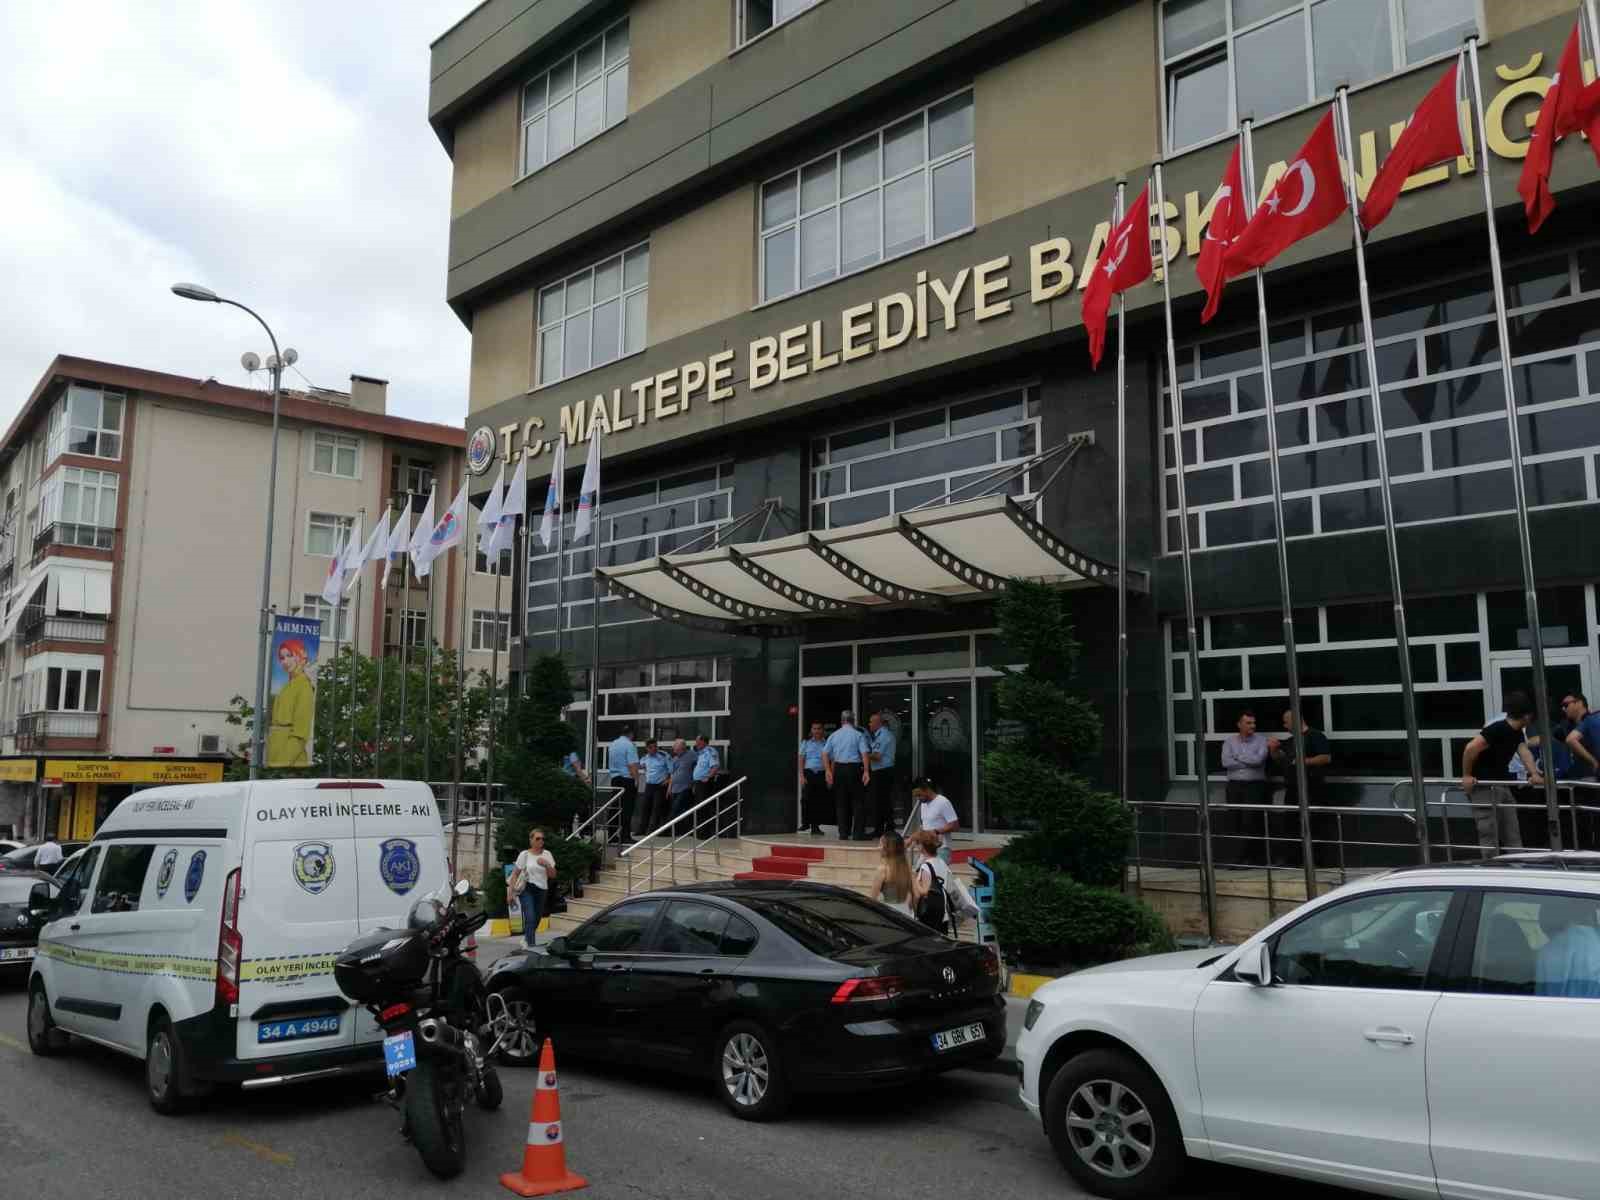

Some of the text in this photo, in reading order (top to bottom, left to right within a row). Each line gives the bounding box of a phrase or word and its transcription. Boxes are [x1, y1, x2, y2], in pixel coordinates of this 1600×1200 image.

[499, 416, 551, 464] T.C.
[560, 349, 734, 445] MALTEPE
[749, 254, 1012, 391] BELEDİYE
[256, 807, 296, 821] OLAY
[300, 802, 332, 818] YERİ
[336, 802, 401, 817] İNCELEME
[256, 965, 281, 975] OLAY
[262, 1017, 338, 1039] 34 A 4946
